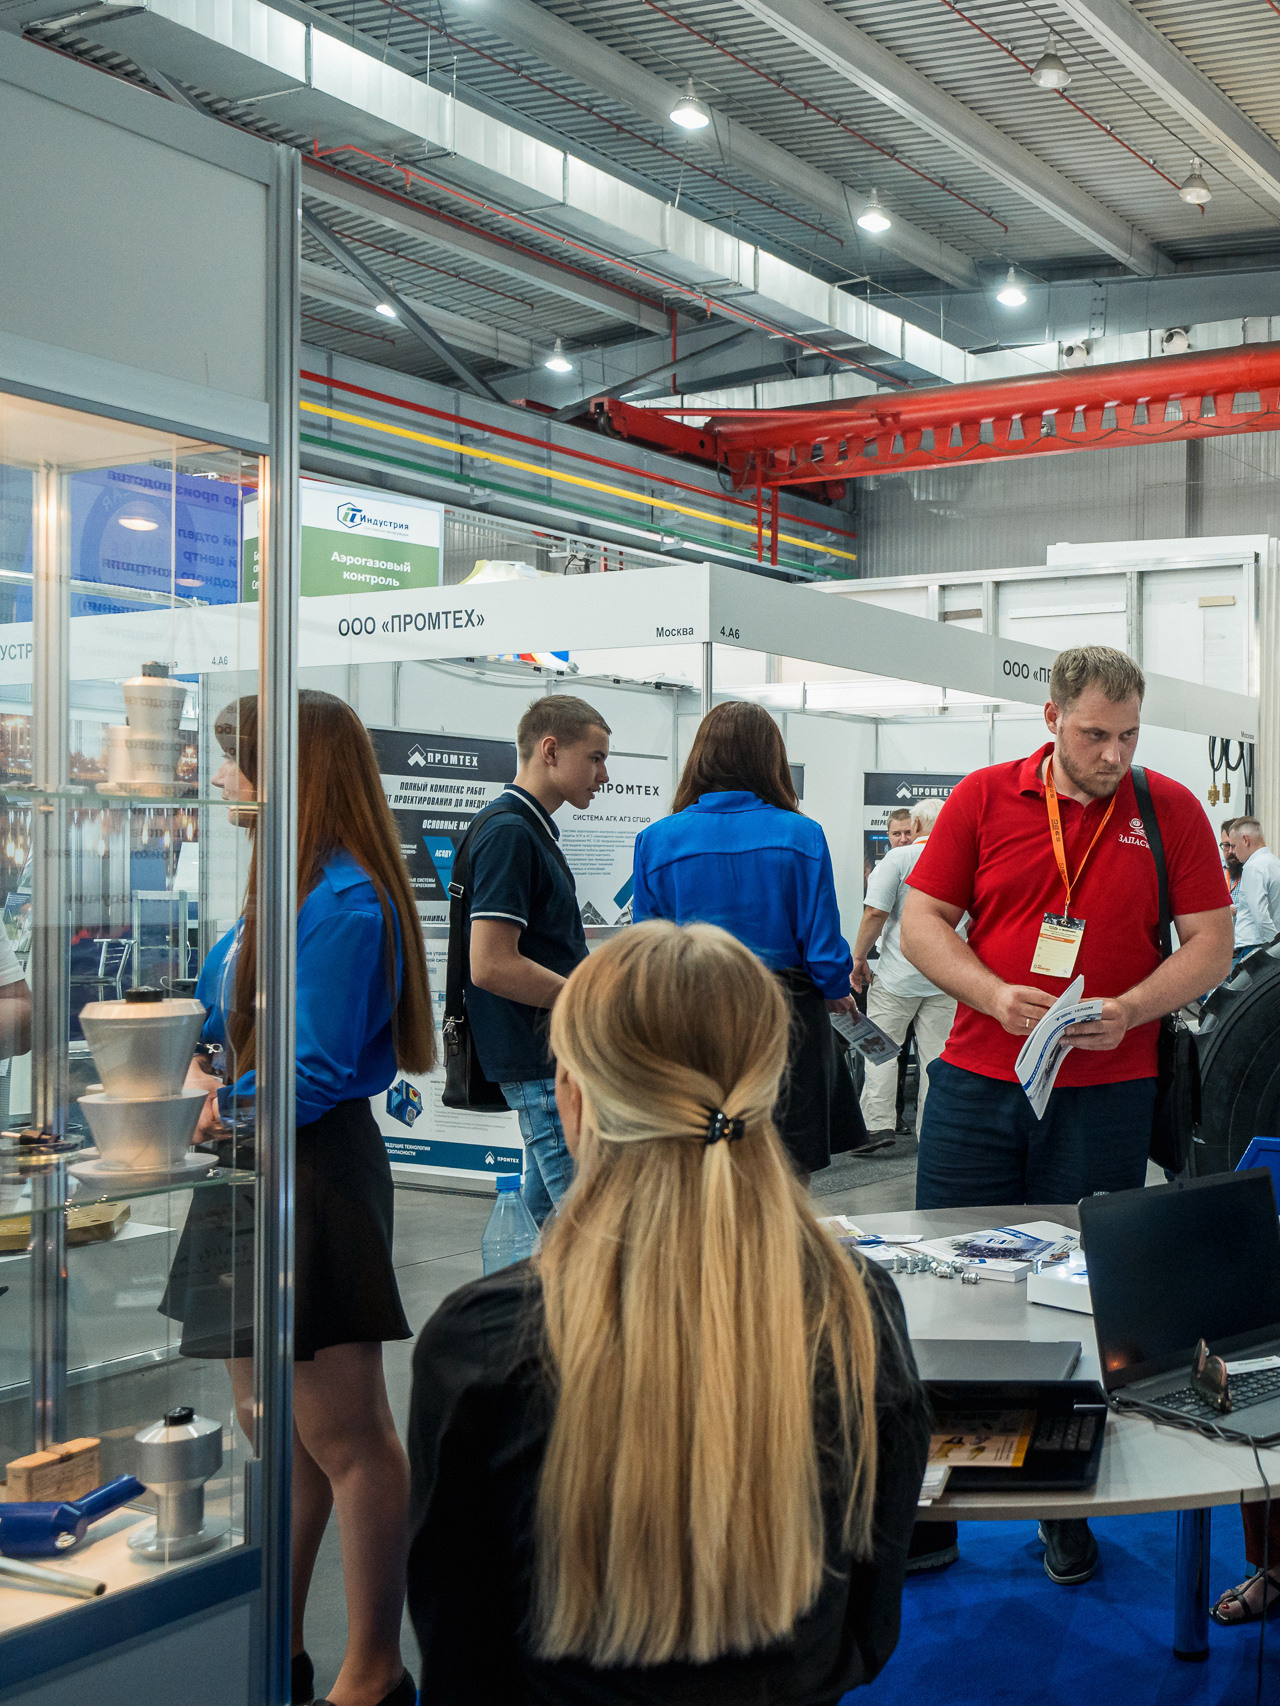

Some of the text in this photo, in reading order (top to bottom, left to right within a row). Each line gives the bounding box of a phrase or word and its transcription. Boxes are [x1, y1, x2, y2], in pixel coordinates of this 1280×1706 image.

[331, 551, 411, 573] Аэрогазовый
[342, 571, 400, 587] контроль
[338, 608, 485, 637] ООО «ПРОМТЕХ»
[656, 627, 694, 638] Москва
[1003, 660, 1030, 680] ООО
[427, 752, 478, 767] ПРОМТЕХ
[400, 781, 486, 796] ПОЛНЫЙ КОМПЛЕКС РАБОТ
[394, 794, 453, 807] ПРОЕКТИРОВАНИЯ
[454, 798, 463, 809] ДО
[422, 819, 459, 831] ОСНОВНЫЕ
[572, 814, 604, 822] СИСТЕМА
[435, 849, 452, 858] АСОДУ
